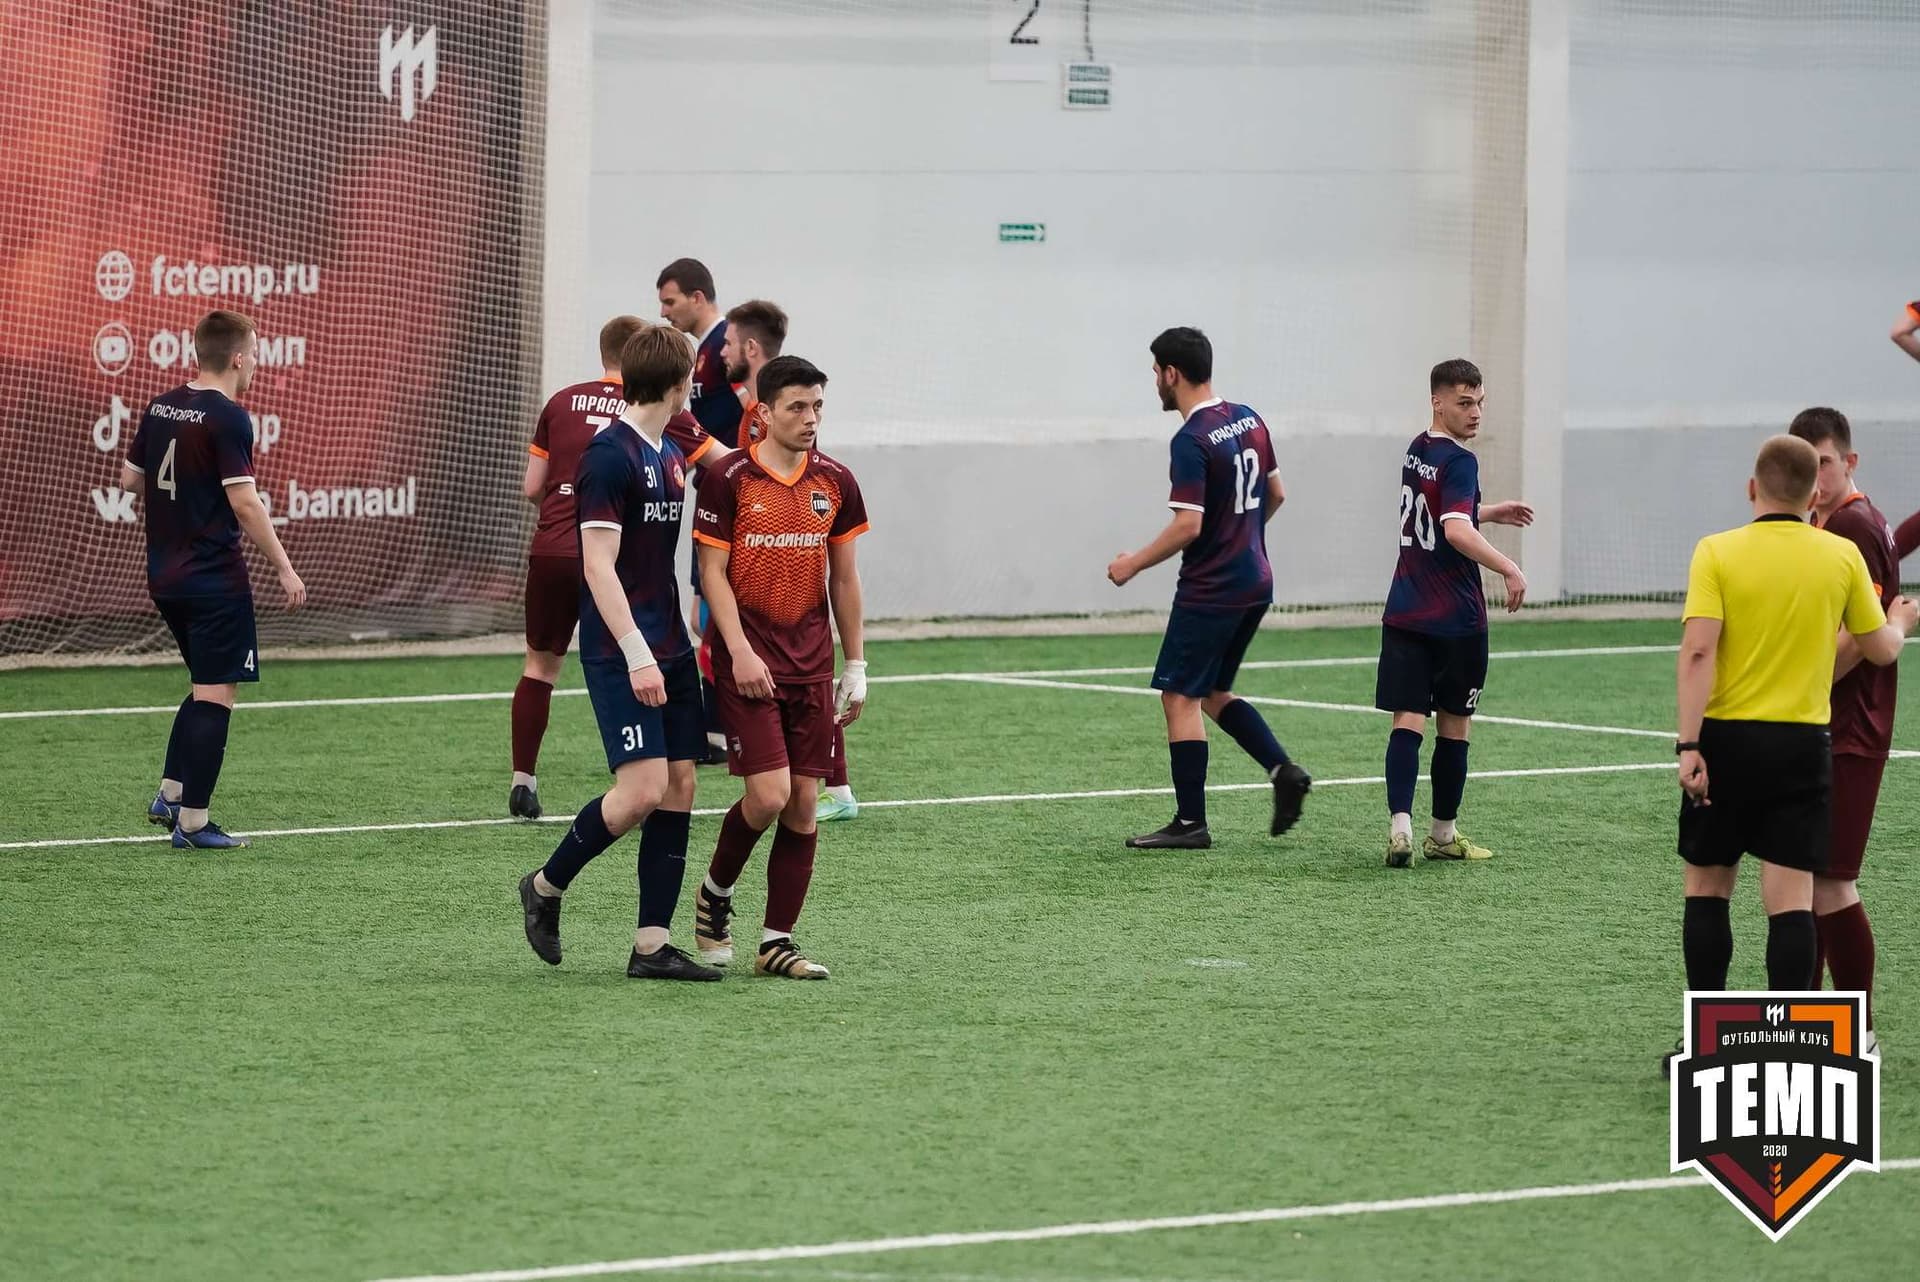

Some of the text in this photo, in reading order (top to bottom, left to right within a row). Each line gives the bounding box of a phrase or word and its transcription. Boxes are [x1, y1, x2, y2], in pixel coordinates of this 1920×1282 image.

[151, 255, 320, 305] fctemp.ru
[571, 394, 627, 416] ТАРАСО
[157, 438, 177, 501] 4
[644, 465, 658, 489] 31
[1234, 448, 1261, 514] 12
[1400, 484, 1436, 551] 20
[745, 531, 828, 548] ПРОДИНВЕС
[244, 649, 255, 672] 4
[621, 724, 644, 752] 31
